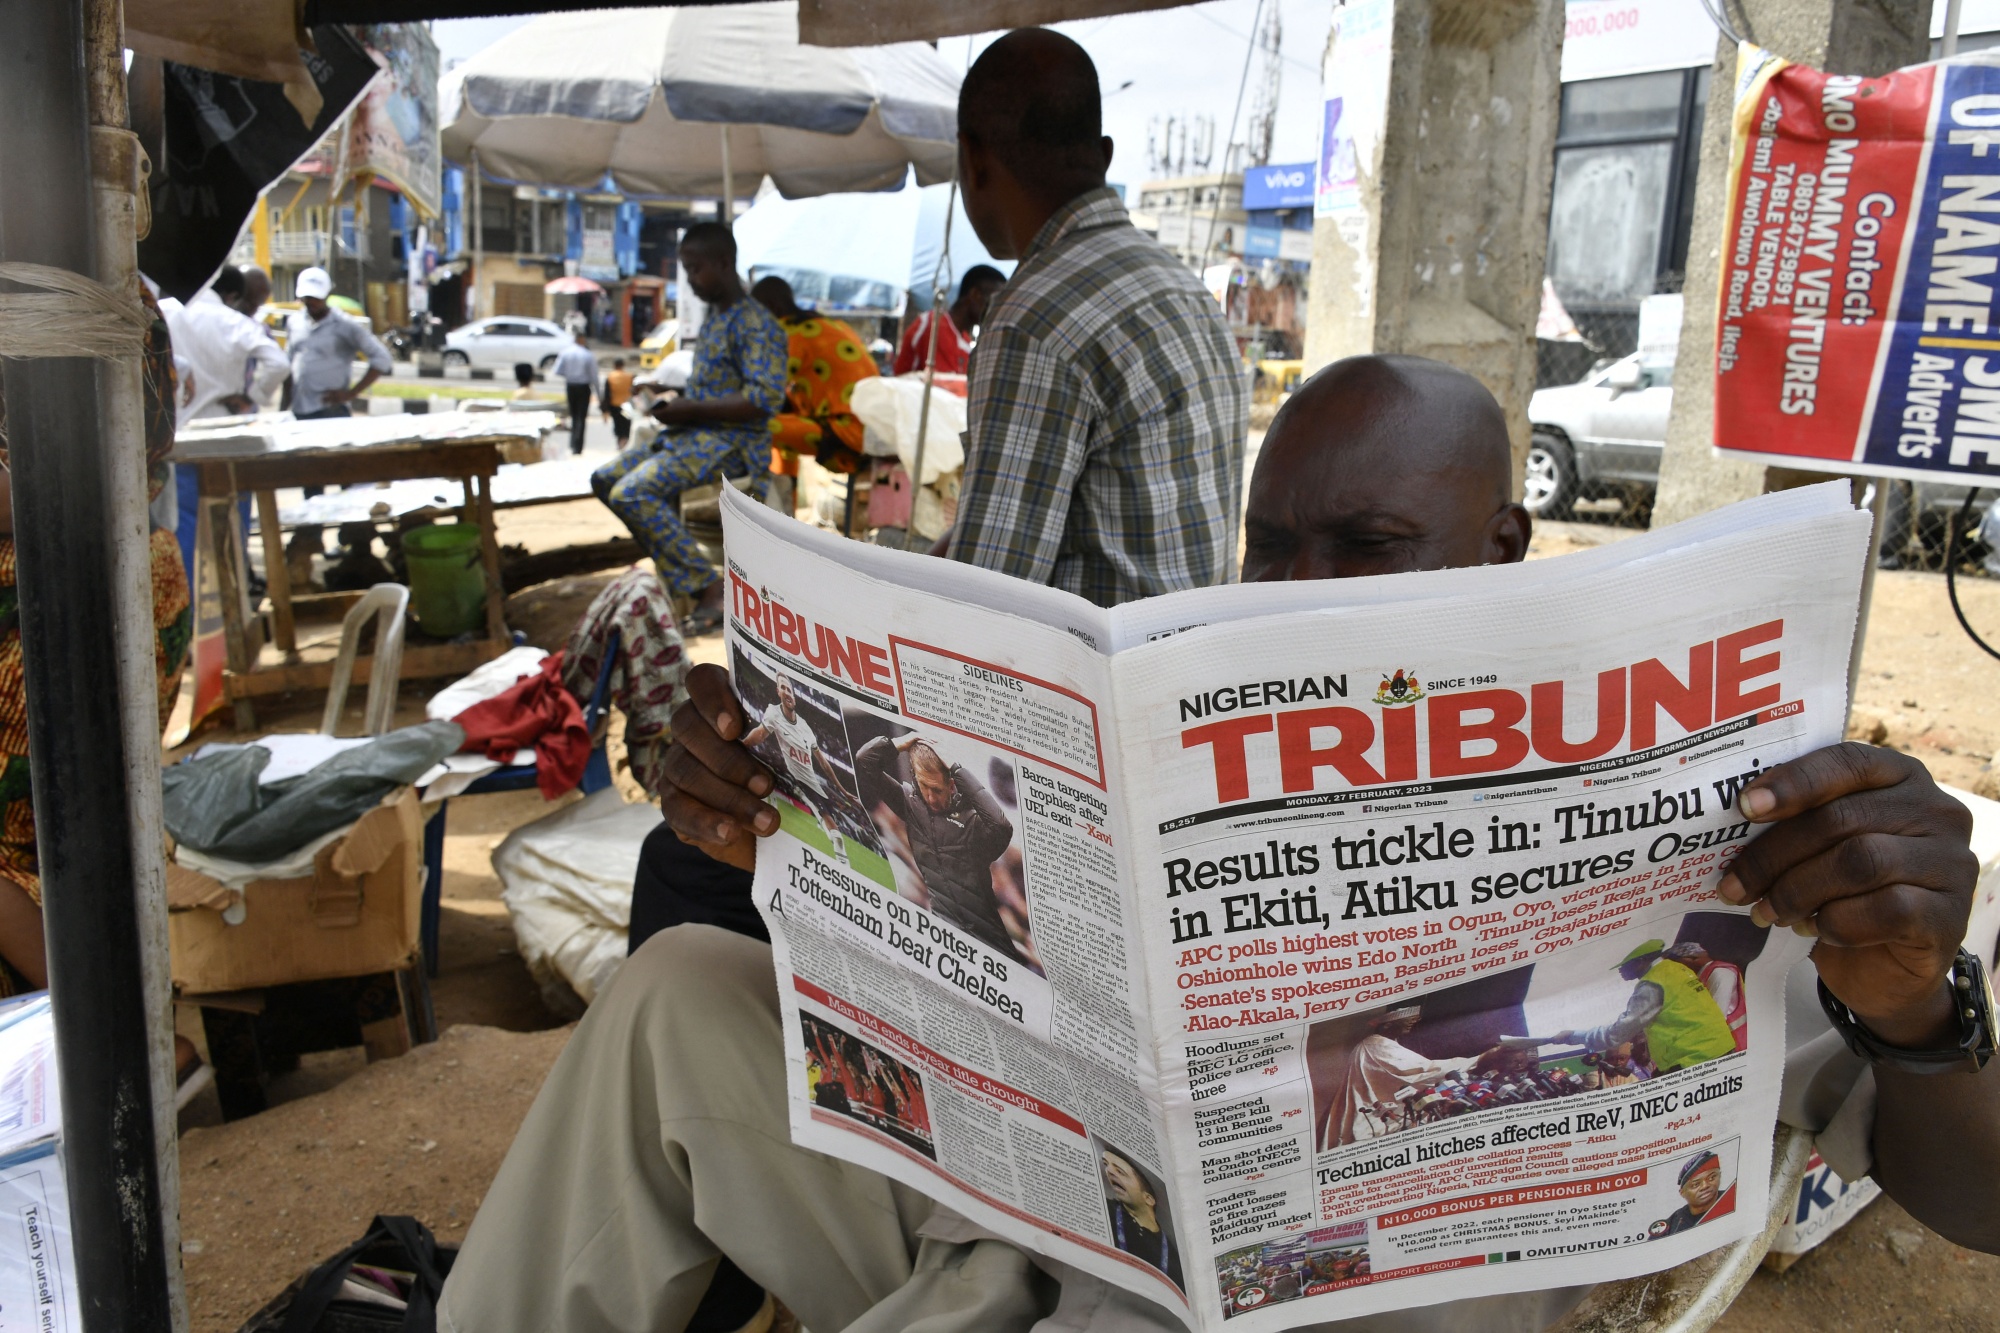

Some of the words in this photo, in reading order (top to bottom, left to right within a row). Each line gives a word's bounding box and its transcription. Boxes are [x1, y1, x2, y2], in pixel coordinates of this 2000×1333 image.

[1264, 169, 1305, 189] vivo
[1765, 162, 1796, 224] TABLE
[1804, 138, 1860, 262] MUMMY
[1734, 177, 1768, 266] Awolowo
[1772, 173, 1817, 306] 08034739891
[1745, 227, 1782, 311] VENDOR,
[1841, 192, 1896, 326] Contact:
[1921, 175, 2000, 333] NAME
[1724, 270, 1751, 322] Road,
[1718, 325, 1742, 375] Ikeja.
[1779, 268, 1834, 416] VENTURES
[1897, 352, 1955, 458] Adverts
[729, 567, 895, 697] TRIBUNE
[922, 666, 955, 683] Scorecard
[985, 685, 1018, 702] President
[1021, 694, 1068, 720] Muhammadu
[1071, 715, 1094, 732] Buhari
[963, 664, 1024, 692] SIDELINES
[1179, 674, 1348, 722] NIGERIAN
[1427, 678, 1466, 691] SINCE
[1469, 674, 1497, 686] 1949
[1181, 619, 1784, 803] TRIBUNE
[789, 745, 812, 766] AIA
[1163, 816, 1196, 831] 18,257
[1233, 809, 1345, 829] www.tribuneonlineng.com
[1374, 803, 1412, 813] Nigerian
[1415, 799, 1448, 809] Tribune
[1484, 785, 1558, 800] @nigeriantribune
[1593, 774, 1629, 786] Nigerian
[1631, 766, 1661, 779] Tribune
[1688, 738, 1744, 763] tribuneonlineng
[1286, 794, 1334, 807] MONDAY,
[1335, 792, 1346, 802] 27
[1349, 788, 1404, 801] FEBRUARY,
[1406, 785, 1432, 794] 2023
[1579, 758, 1624, 773] NIGERIA'S
[1626, 751, 1650, 764] MOST
[1651, 734, 1702, 757] INFORMATIVE
[1703, 719, 1749, 739] NEWSPAPER
[1770, 702, 1799, 718] N200
[1021, 765, 1055, 790] Barca
[1057, 781, 1108, 815] targeting
[1024, 798, 1048, 818] UEL
[1050, 810, 1073, 828] exit
[1030, 786, 1076, 814] trophies
[1079, 807, 1105, 828] after
[1163, 840, 1320, 899] Results
[1332, 821, 1475, 871] trickle
[1487, 815, 1541, 854] in:
[1554, 784, 1704, 844] Tinubu
[1170, 907, 1212, 944] in
[1221, 886, 1330, 934] Ekiti,
[1341, 875, 1458, 921] Atiku
[1471, 849, 1635, 905] secures
[1648, 821, 1750, 863] Osun
[1228, 939, 1277, 962] polls
[1282, 931, 1359, 955] highest
[1363, 923, 1418, 945] votes
[1423, 920, 1442, 937] in
[1449, 910, 1507, 933] Ogun,
[1513, 901, 1555, 923] Oyo,
[1561, 870, 1652, 904] victorious
[1655, 864, 1674, 878] in
[1678, 852, 1715, 872] Edo
[788, 864, 884, 940] Tottenham
[887, 922, 933, 969] beat
[937, 952, 1025, 1024] Chelsea
[802, 847, 881, 909] Pressure
[886, 900, 912, 928] on
[916, 910, 978, 964] Potter
[982, 955, 1008, 983] as
[1177, 960, 1298, 989] Oshiomhole
[1302, 955, 1353, 975] wins
[1358, 949, 1397, 967] Edo
[1402, 936, 1457, 960] North
[1551, 900, 1597, 927] loses
[1604, 884, 1646, 908] Ikeja
[1651, 871, 1692, 891] LGA
[1697, 865, 1714, 877] to
[1272, 972, 1390, 1002] spokesman,
[1395, 951, 1465, 978] Bashiru
[1471, 938, 1519, 960] loses
[1660, 881, 1702, 901] wins
[1303, 997, 1349, 1019] Jerry
[1355, 980, 1418, 1004] Gana's
[1423, 966, 1466, 986] sons
[1471, 955, 1506, 973] win
[1511, 948, 1528, 963] in
[1535, 936, 1573, 957] Oyo,
[1578, 915, 1631, 943] Niger
[827, 996, 855, 1020] Man
[858, 1010, 879, 1032] Utd
[881, 1023, 909, 1048] ends
[912, 1039, 950, 1073] 6-year
[952, 1058, 979, 1088] title
[982, 1080, 1040, 1114] drought
[1185, 1039, 1260, 1057] Hoodlums
[1264, 1032, 1285, 1044] set
[1187, 1061, 1225, 1077] INEC
[1229, 1055, 1249, 1066] LG
[1253, 1044, 1295, 1059] office,
[1189, 1069, 1231, 1089] police
[1236, 1057, 1275, 1074] arrest
[949, 1079, 984, 1103] Carabao
[985, 1098, 1005, 1112] Cup
[1191, 1083, 1227, 1101] three
[1194, 1097, 1264, 1119] Suspected
[1196, 1111, 1246, 1128] herders
[1250, 1105, 1270, 1117] kill
[1198, 1128, 1213, 1138] 13
[1216, 1123, 1228, 1134] in
[1232, 1115, 1273, 1130] Benue
[1198, 1123, 1283, 1148] communities
[1317, 1153, 1410, 1185] Technical
[1416, 1135, 1486, 1161] hitches
[1491, 1117, 1570, 1148] affected
[1576, 1107, 1625, 1134] IReV,
[1629, 1091, 1679, 1124] INEC
[1683, 1075, 1743, 1108] admits
[25, 1206, 44, 1250] Teach
[1384, 1207, 1437, 1226] N10,000
[1441, 1197, 1486, 1214] BONUS
[1490, 1193, 1514, 1204] PER
[1518, 1179, 1592, 1200] PENSIONER
[1596, 1176, 1612, 1189] IN
[1614, 1173, 1641, 1187] OYO
[1373, 1267, 1422, 1282] SUPPORT
[1424, 1260, 1461, 1272] GROUP
[1526, 1238, 1618, 1258] OMITUNTUN
[1623, 1232, 1645, 1244] 2.0
[31, 1252, 53, 1305] yourself
